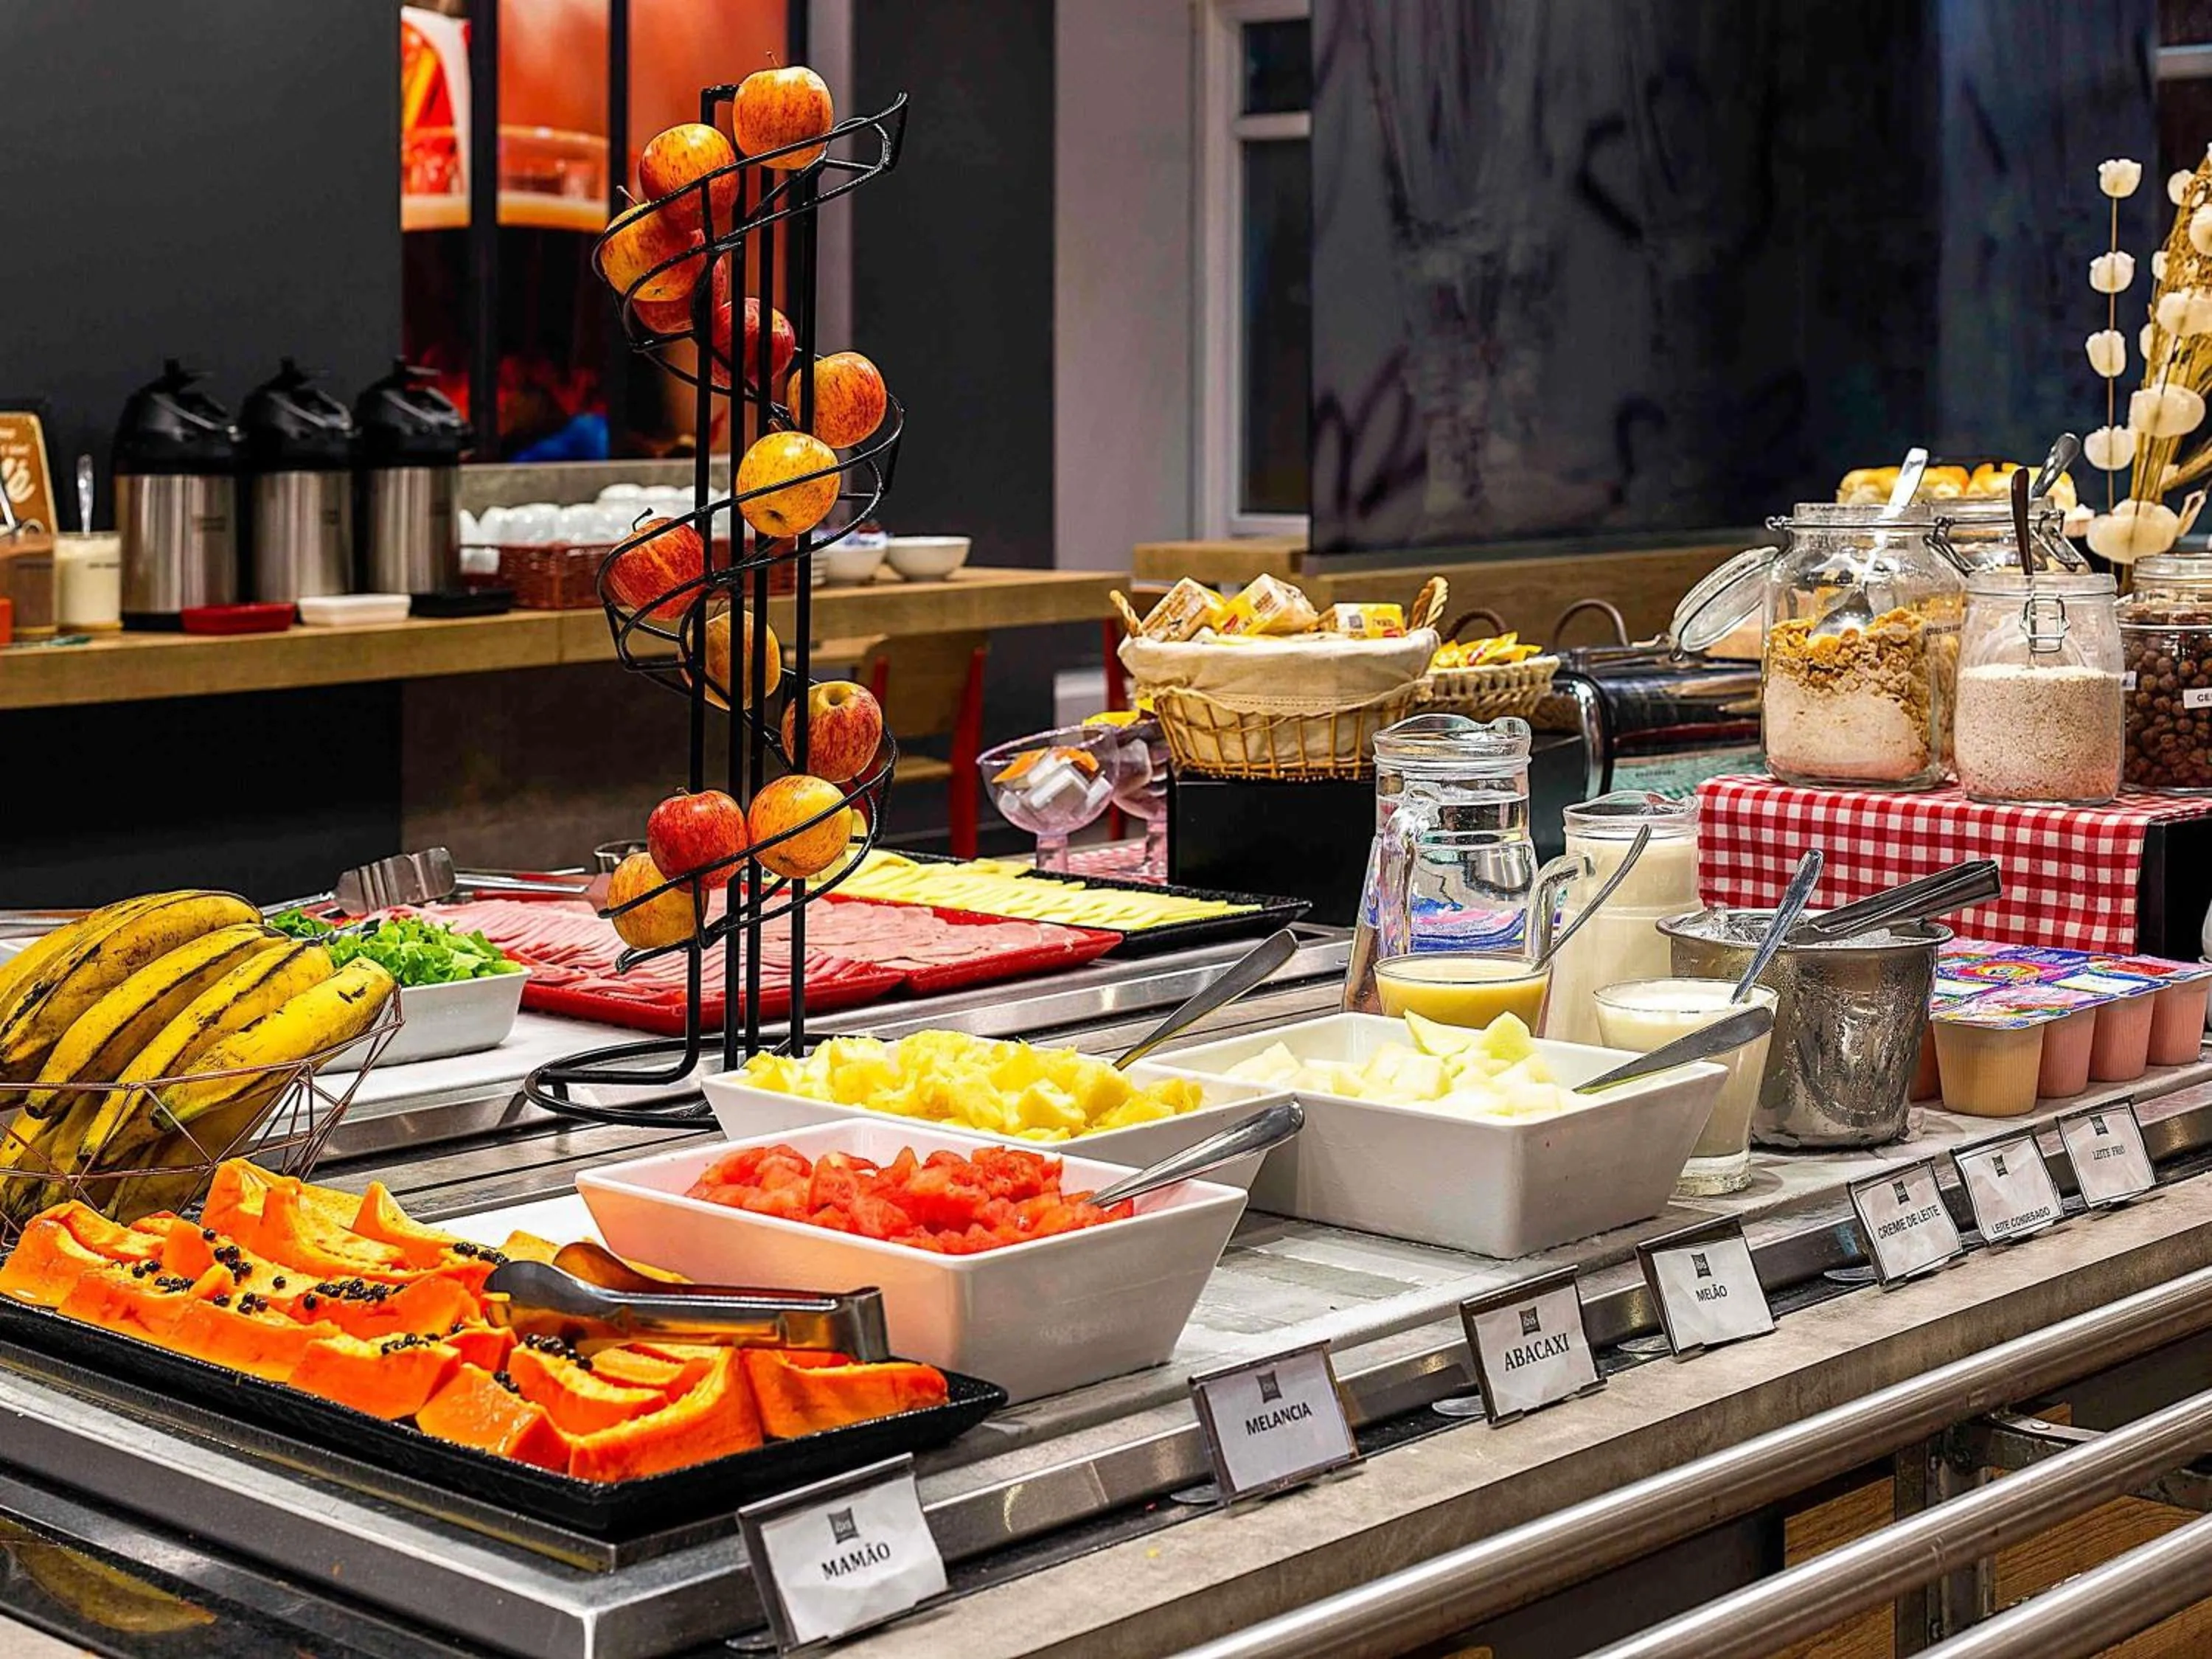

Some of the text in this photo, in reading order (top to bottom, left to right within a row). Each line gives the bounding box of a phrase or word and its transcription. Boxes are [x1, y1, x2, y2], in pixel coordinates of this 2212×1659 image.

[1878, 1204, 1941, 1239] CREME DE LEITE
[1992, 1220, 2010, 1234] LEITE
[1696, 1284, 1728, 1302] MELÃO
[1505, 1332, 1570, 1371] ABACAXI
[1245, 1402, 1312, 1436] MELANCIA
[821, 1543, 891, 1580] MAMÃO
